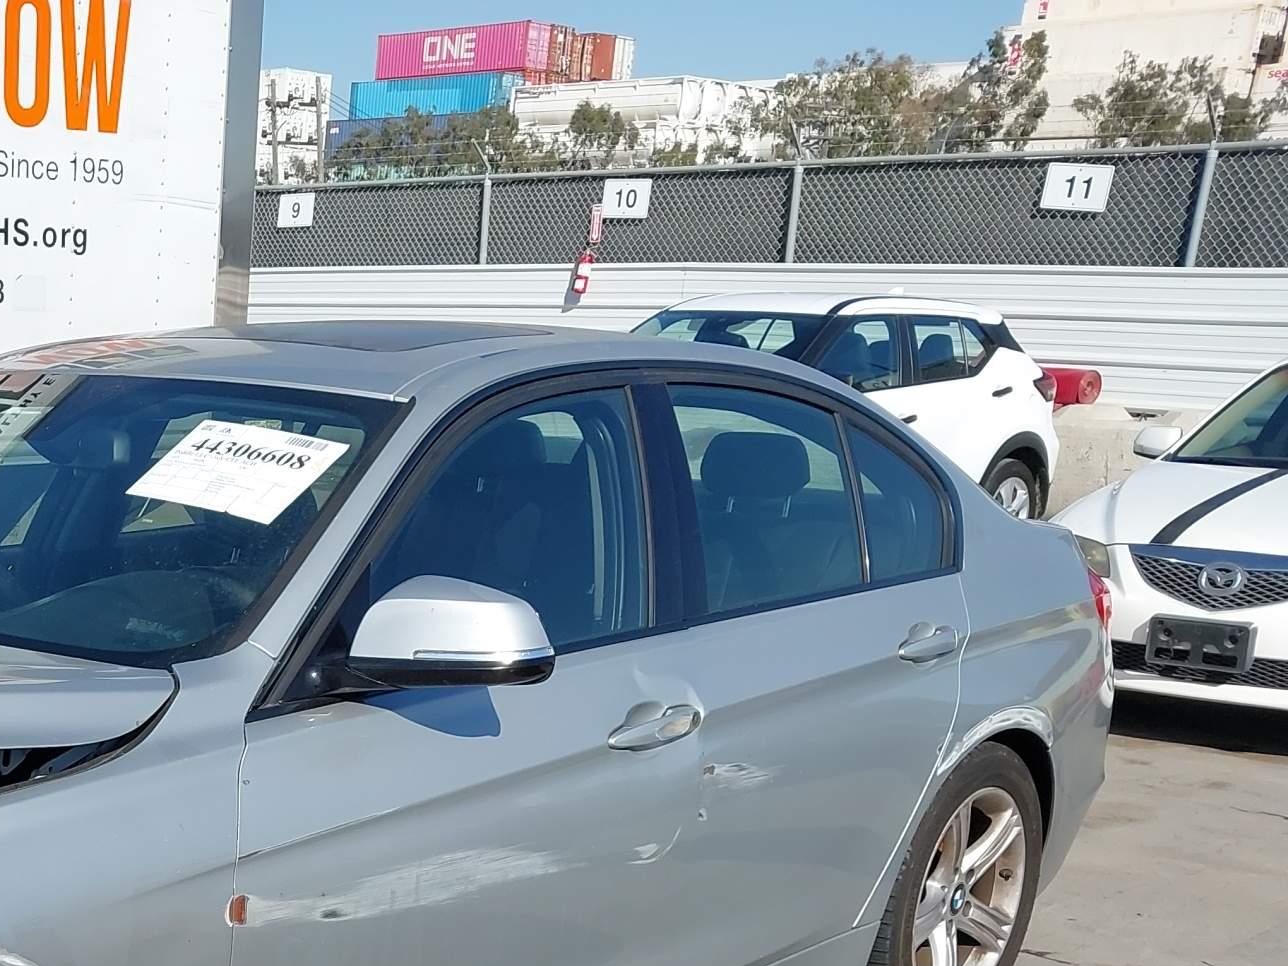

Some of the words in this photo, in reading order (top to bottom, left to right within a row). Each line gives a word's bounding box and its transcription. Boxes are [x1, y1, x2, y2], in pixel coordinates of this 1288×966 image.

[423, 32, 476, 62] ONE
[69, 156, 124, 185] 1959
[616, 189, 638, 209] 10
[1065, 176, 1093, 199] 11
[290, 202, 301, 219] 9
[192, 437, 312, 471] 44306608
